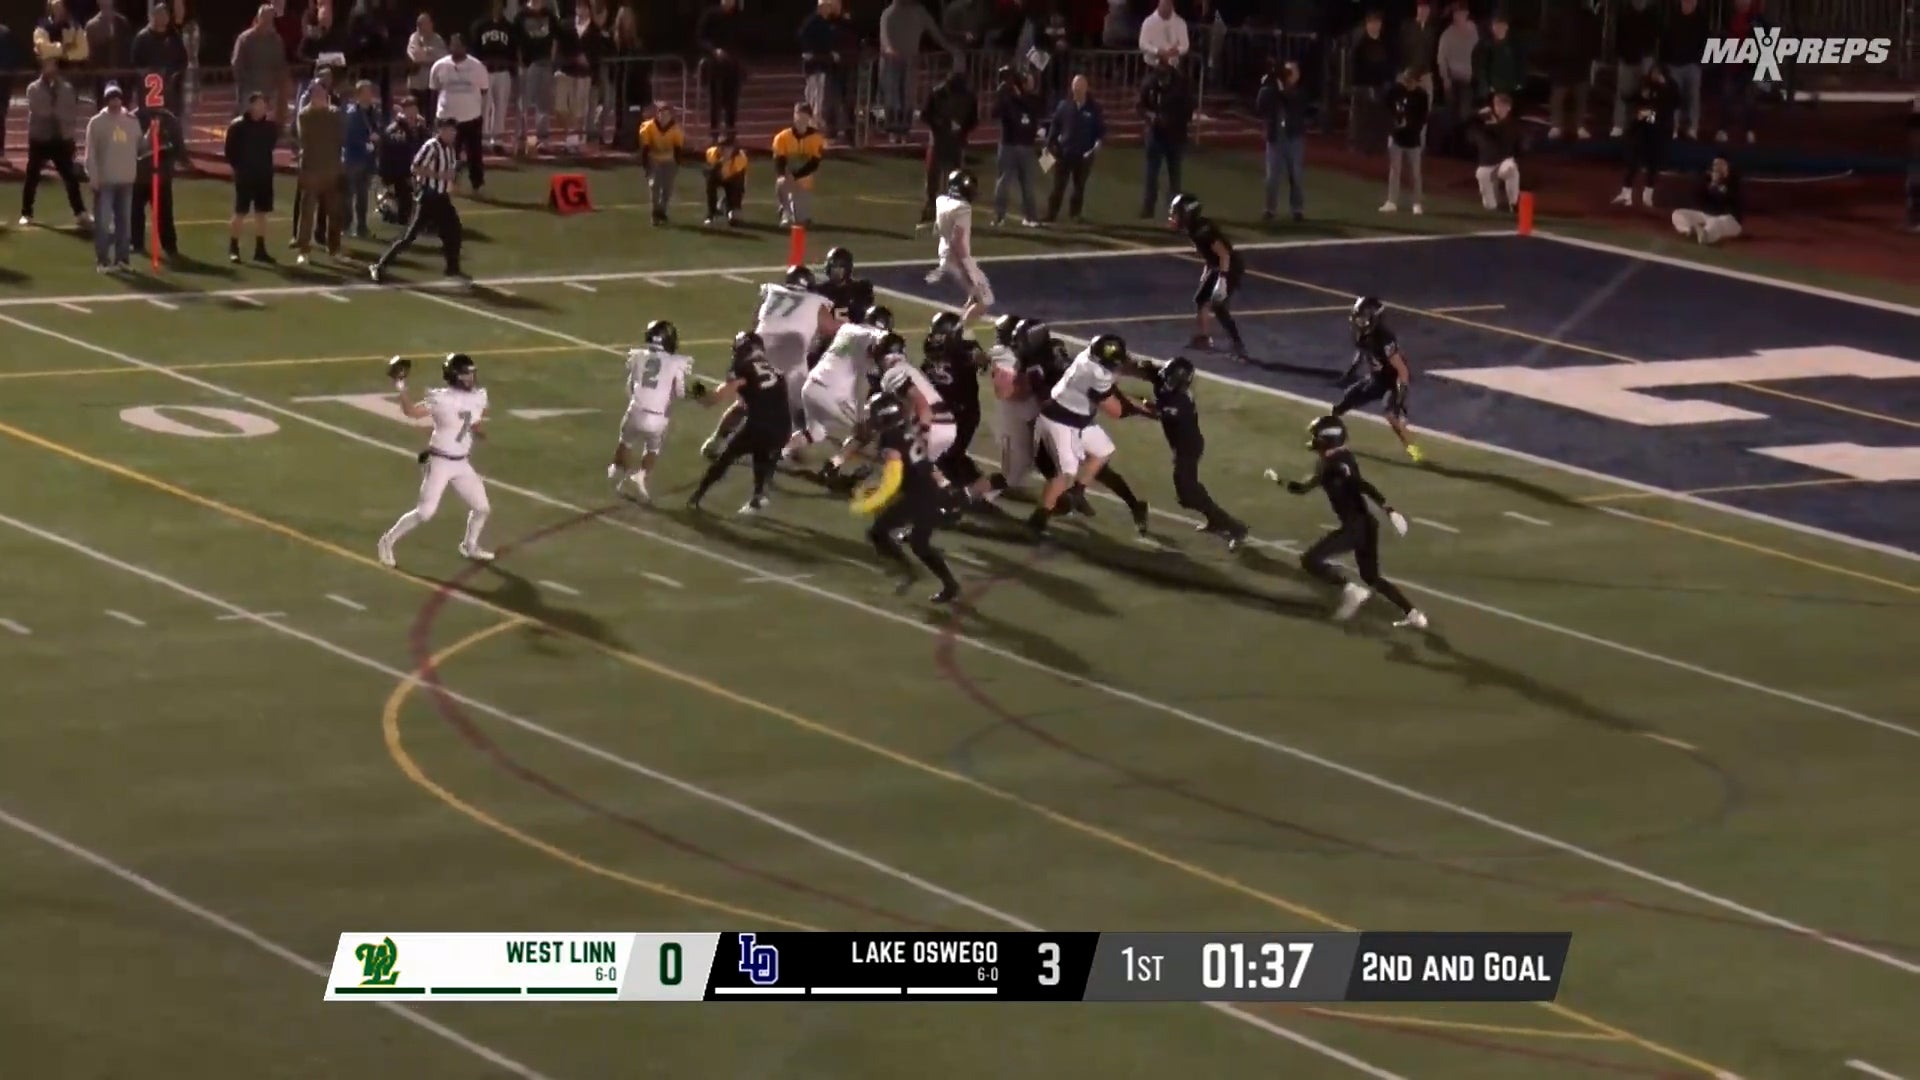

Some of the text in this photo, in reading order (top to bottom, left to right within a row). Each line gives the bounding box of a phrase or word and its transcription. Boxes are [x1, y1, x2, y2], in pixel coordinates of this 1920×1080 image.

[144, 73, 165, 108] 2
[560, 178, 587, 208] G
[766, 290, 805, 317] 77
[642, 355, 661, 390] 2
[455, 410, 472, 443] 7
